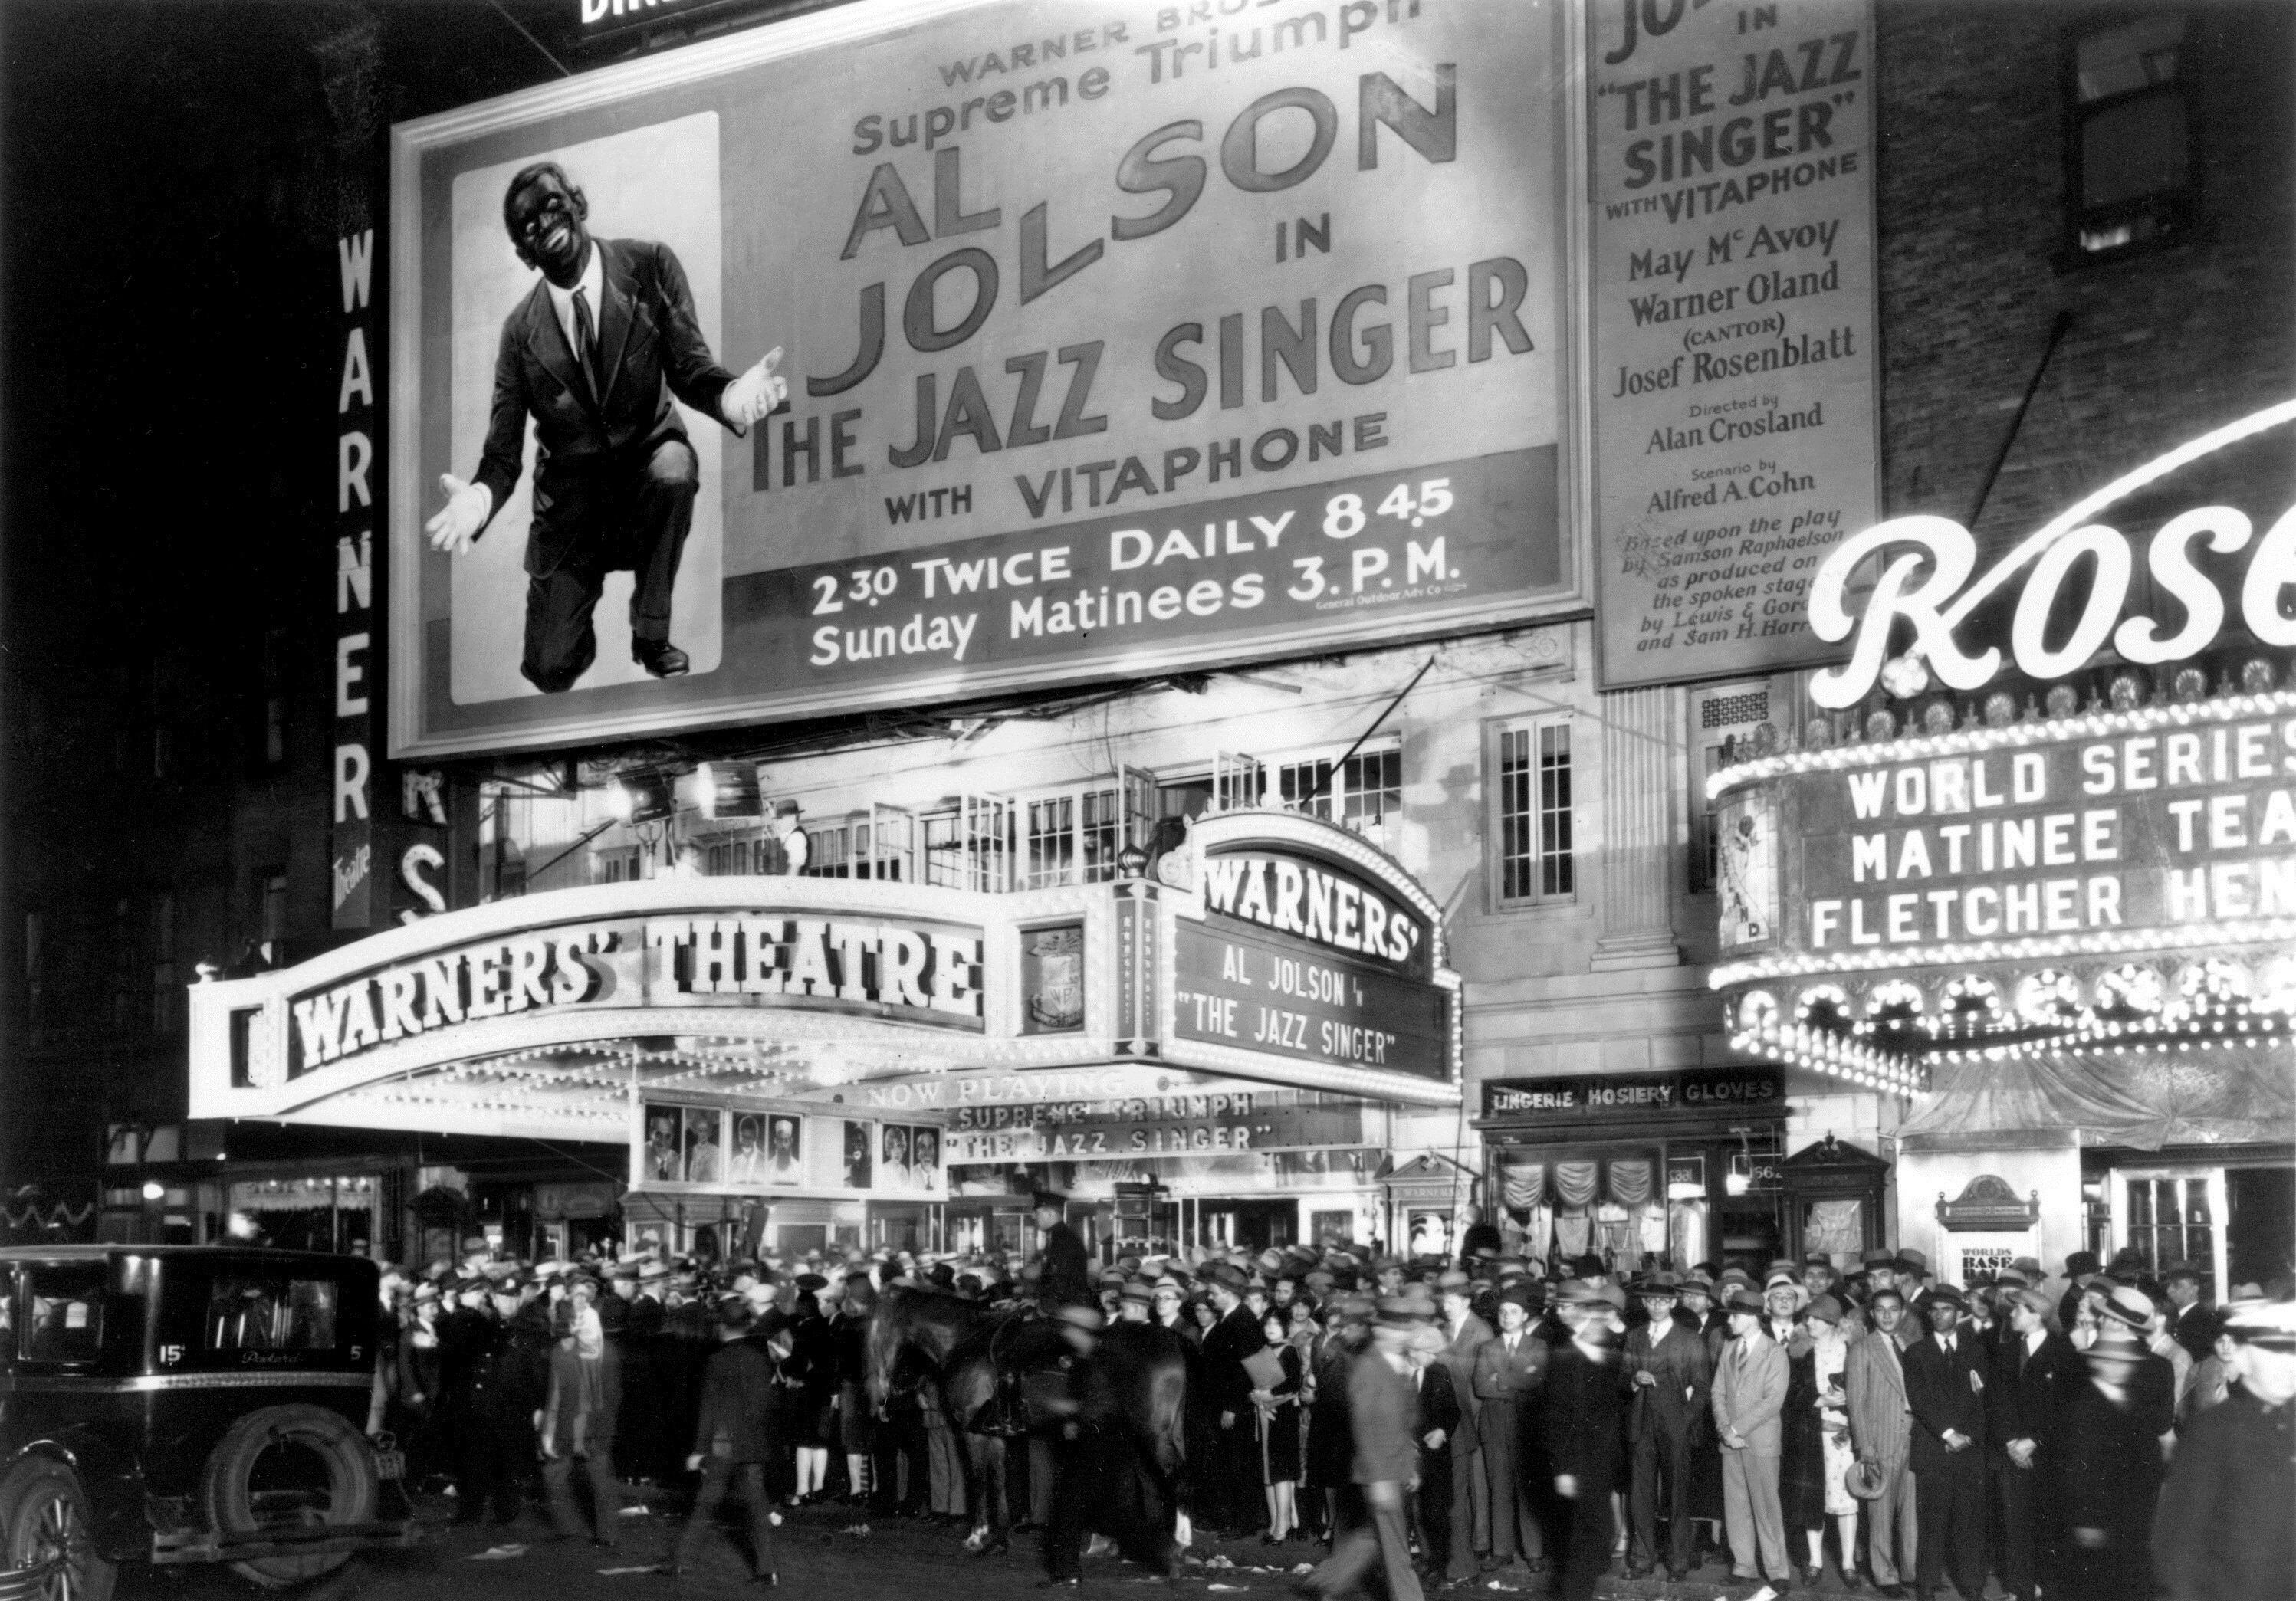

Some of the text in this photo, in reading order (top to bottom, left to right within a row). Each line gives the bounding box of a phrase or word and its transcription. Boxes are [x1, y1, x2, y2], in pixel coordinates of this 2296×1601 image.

[1738, 5, 1778, 34] IN
[938, 21, 1130, 87] WARNER
[1598, 31, 1862, 130] "THE JAZZ
[852, 66, 1111, 153] Supreme
[1624, 90, 1855, 189] SINGER"
[839, 146, 1001, 261] AL
[1606, 152, 1858, 224] WITH VITAPHONE
[806, 63, 1456, 397] JOLSON
[1276, 212, 1330, 262] IN
[1628, 248, 1694, 283] May
[1628, 260, 1838, 326] Warner Oland
[1683, 311, 1785, 351] (CANTOR)
[753, 257, 1534, 492] THE JAZZ SINGER
[1612, 326, 1855, 398] Josef Rosenblatt
[1645, 402, 1825, 454] Alan Crosland
[1689, 394, 1779, 418] Directed by
[885, 412, 1388, 525] WITH VITAPHONE
[1691, 460, 1776, 481] Scenario by
[336, 230, 373, 822] WARNER
[1647, 481, 1717, 514] Alfred
[912, 546, 1071, 599] TWICE
[1110, 510, 1296, 571] DAILY
[1658, 543, 1733, 567] Samson
[1739, 530, 1844, 557] Raphaelson
[1693, 524, 1741, 546] upon
[1749, 517, 1782, 534] the
[1790, 510, 1841, 534] play
[1653, 593, 1683, 609] the
[1689, 585, 1756, 608] spoken
[1657, 556, 1817, 591] as produced on
[810, 614, 978, 665] Sunday
[1010, 573, 1266, 638] Matinees
[1637, 633, 1674, 651] and
[1683, 627, 1728, 647] Sam
[1641, 616, 1664, 633] by
[1674, 606, 1733, 628] Lewis
[1848, 752, 2048, 819] WORLD
[1851, 809, 2118, 882] MATINEE
[1812, 875, 2122, 947] FLETCHER
[646, 920, 984, 1015] THEATRE
[1223, 945, 1251, 984] AL
[1268, 956, 1344, 1007] JOLSON
[1177, 991, 1395, 1064] "THE JAZZ SINGER"
[869, 1074, 1125, 1107] NOW PLAYING
[960, 1092, 1250, 1129] SUPREME TRIUMPH
[1493, 1081, 1773, 1110] LINGERIE HOSIERY GLOVES
[945, 1124, 1272, 1158] "THE JAZZ SINGER"
[1963, 1256, 2012, 1268] BASE
[350, 1345, 362, 1360] 5
